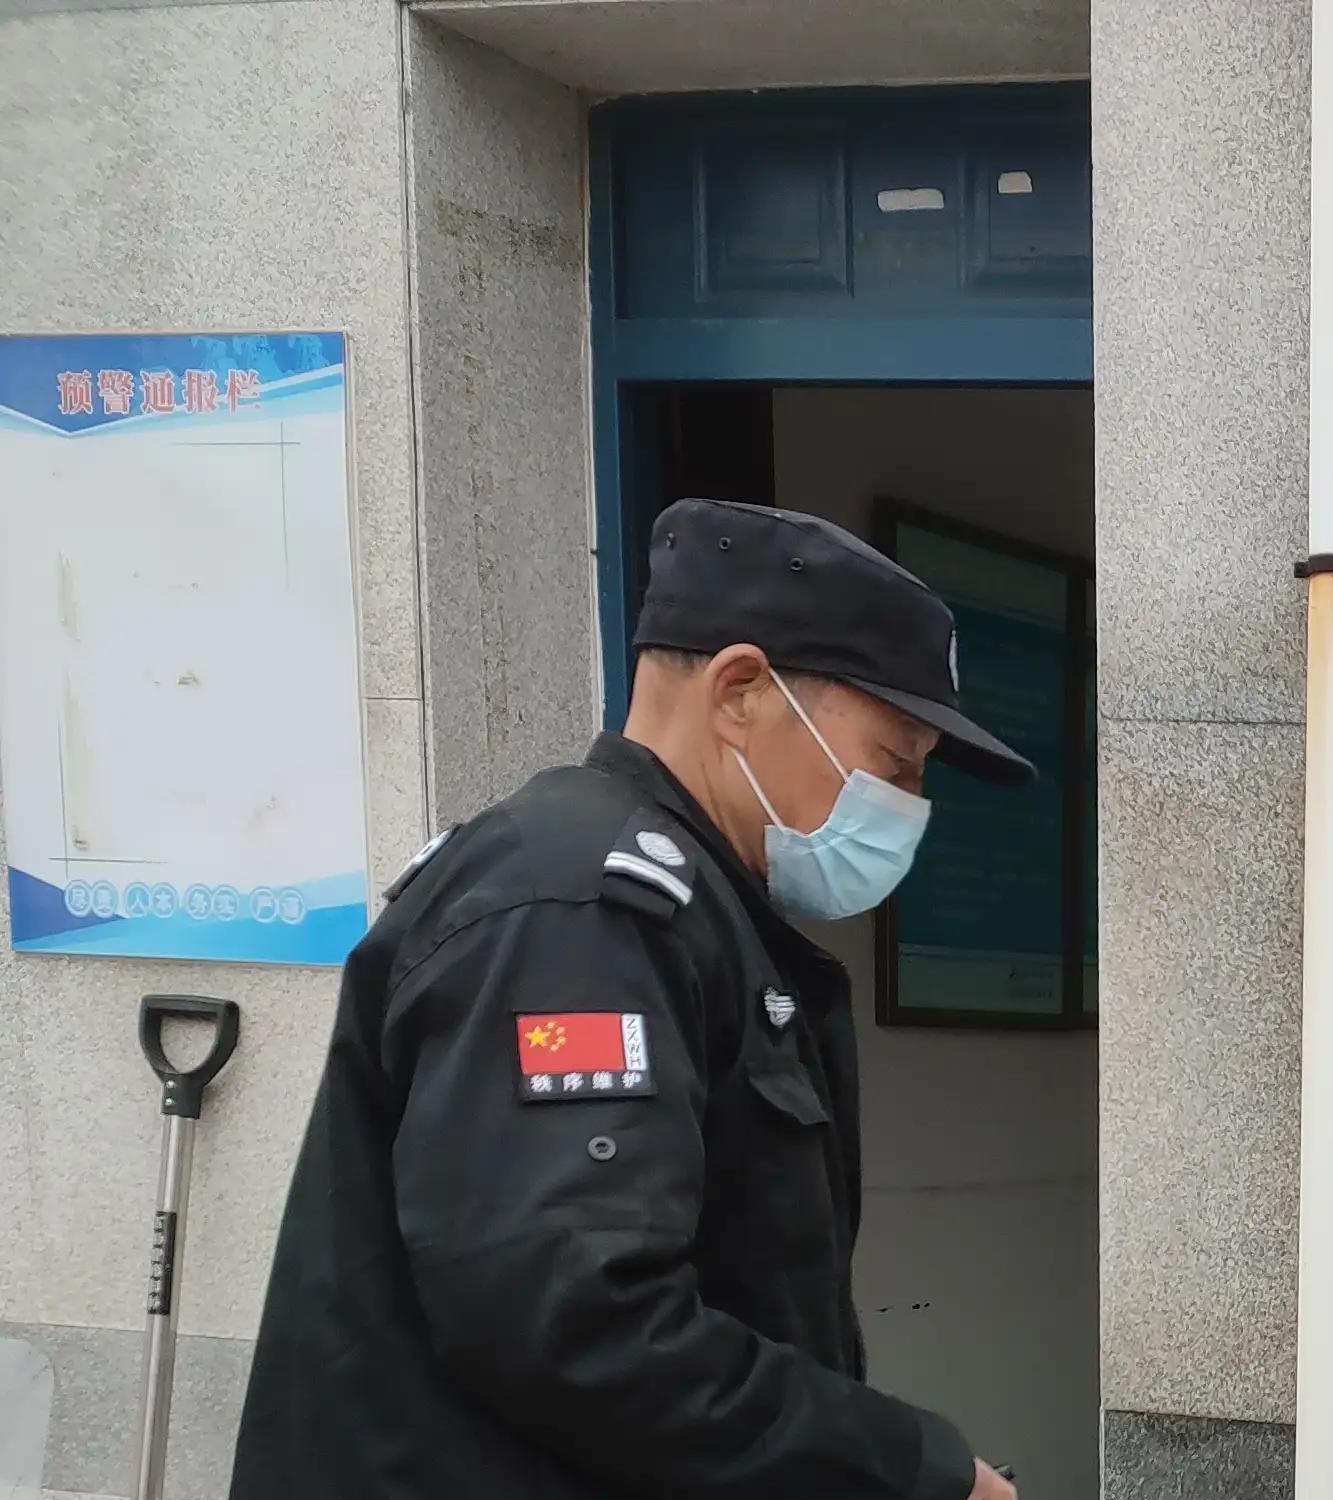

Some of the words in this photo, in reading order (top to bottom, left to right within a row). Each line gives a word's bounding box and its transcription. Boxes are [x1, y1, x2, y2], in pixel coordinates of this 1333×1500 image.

[56, 369, 263, 415] 预警通报栏
[530, 1071, 643, 1092] 秩序维护
